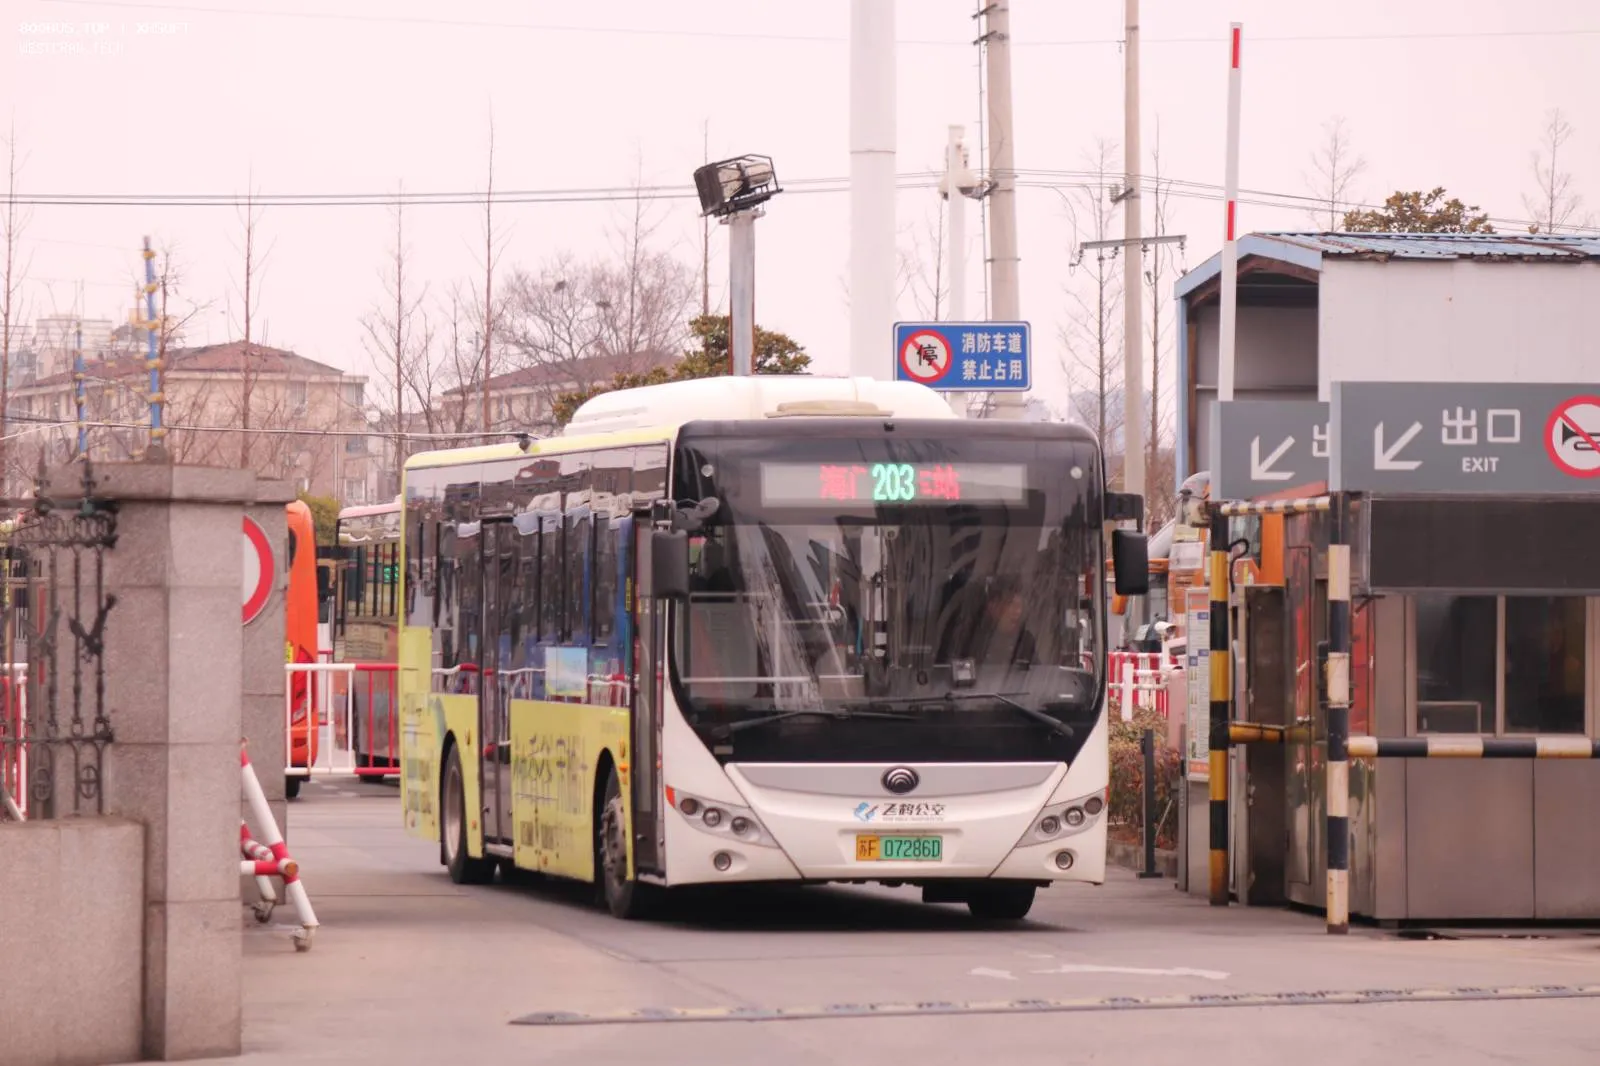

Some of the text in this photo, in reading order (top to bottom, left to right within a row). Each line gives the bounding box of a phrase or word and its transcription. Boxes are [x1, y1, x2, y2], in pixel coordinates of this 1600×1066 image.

[962, 332, 1022, 354] 消防车道
[916, 344, 938, 366] 停
[962, 359, 1022, 381] 禁止占用
[1441, 406, 1521, 445] 出口
[1462, 457, 1499, 473] EXIT
[872, 464, 915, 501] 203
[884, 839, 941, 858] 07286D
